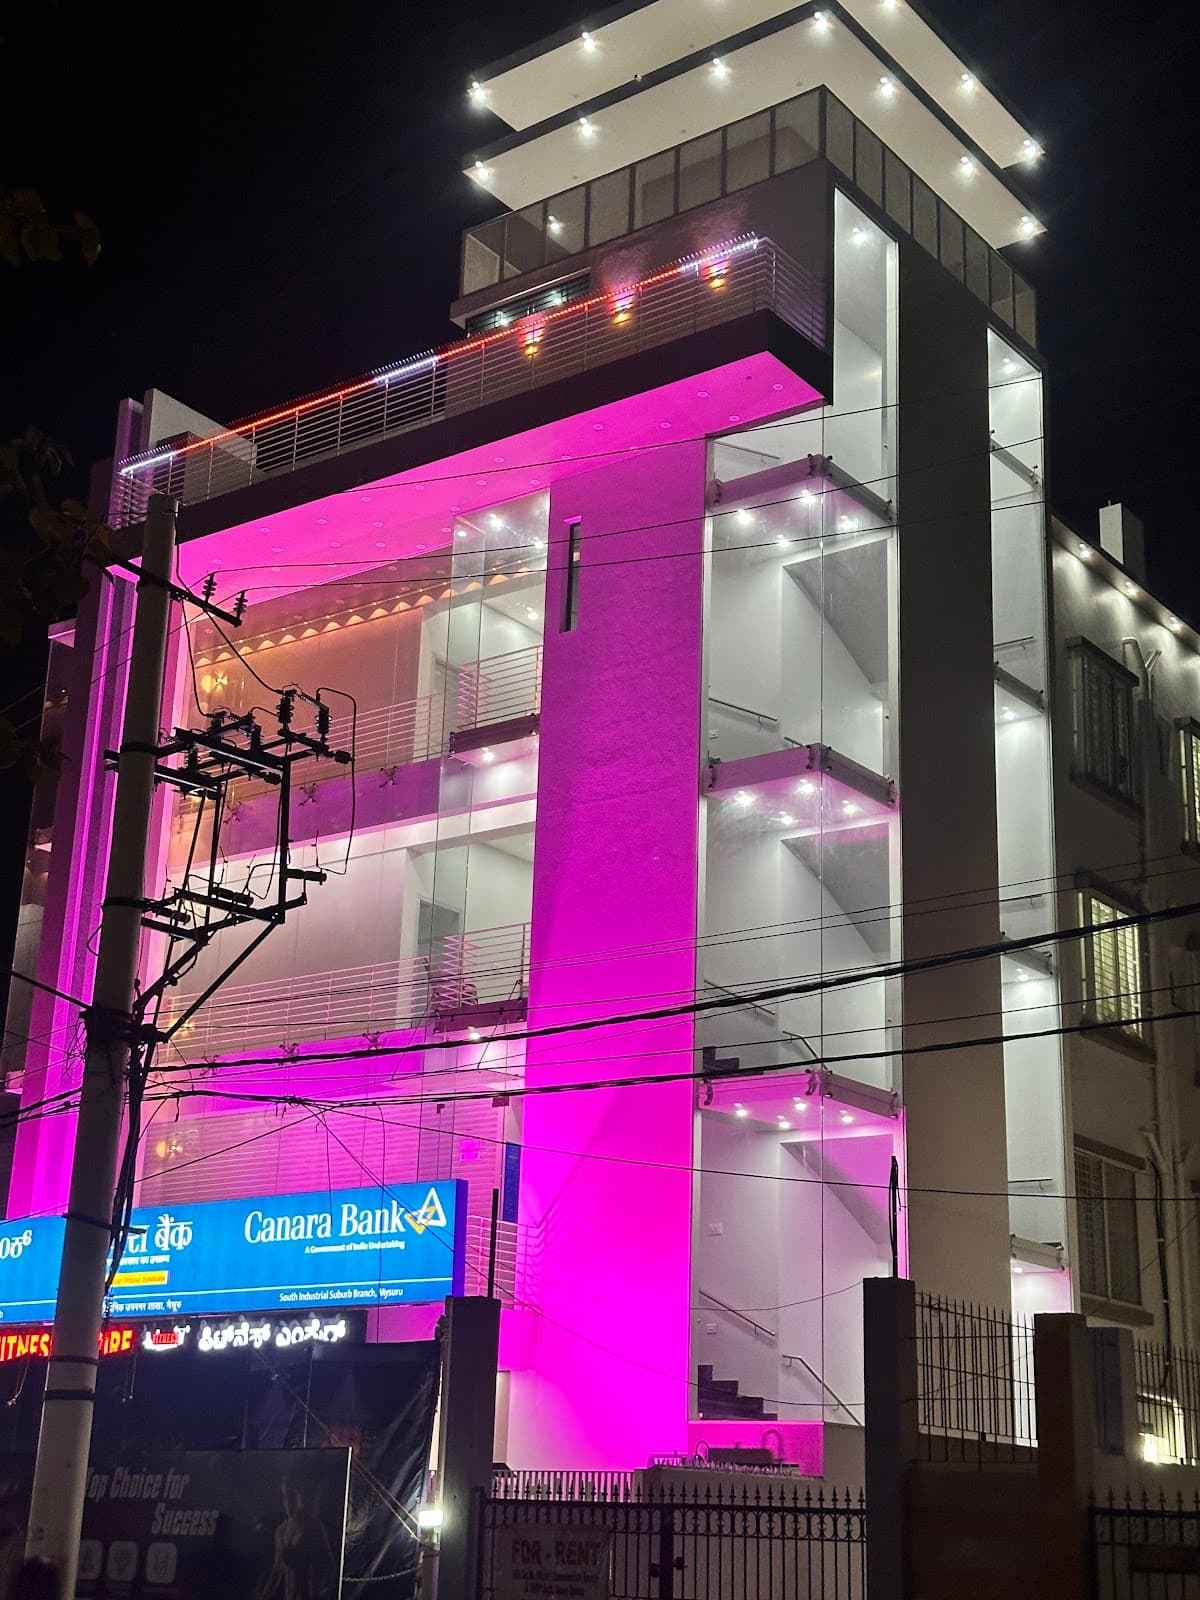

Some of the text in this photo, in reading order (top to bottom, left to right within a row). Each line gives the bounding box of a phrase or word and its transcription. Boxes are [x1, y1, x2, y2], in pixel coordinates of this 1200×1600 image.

[154, 1213, 194, 1251] बैंक
[244, 1200, 406, 1244] Canara Bank
[279, 1287, 404, 1303] South Industrial Suburb Branch, Mysuru
[0, 1330, 133, 1361] ITNES IRE
[110, 1466, 163, 1500] Choice
[163, 1467, 190, 1500] for
[152, 1502, 219, 1536] Success
[512, 1540, 601, 1566] FOR RENT
